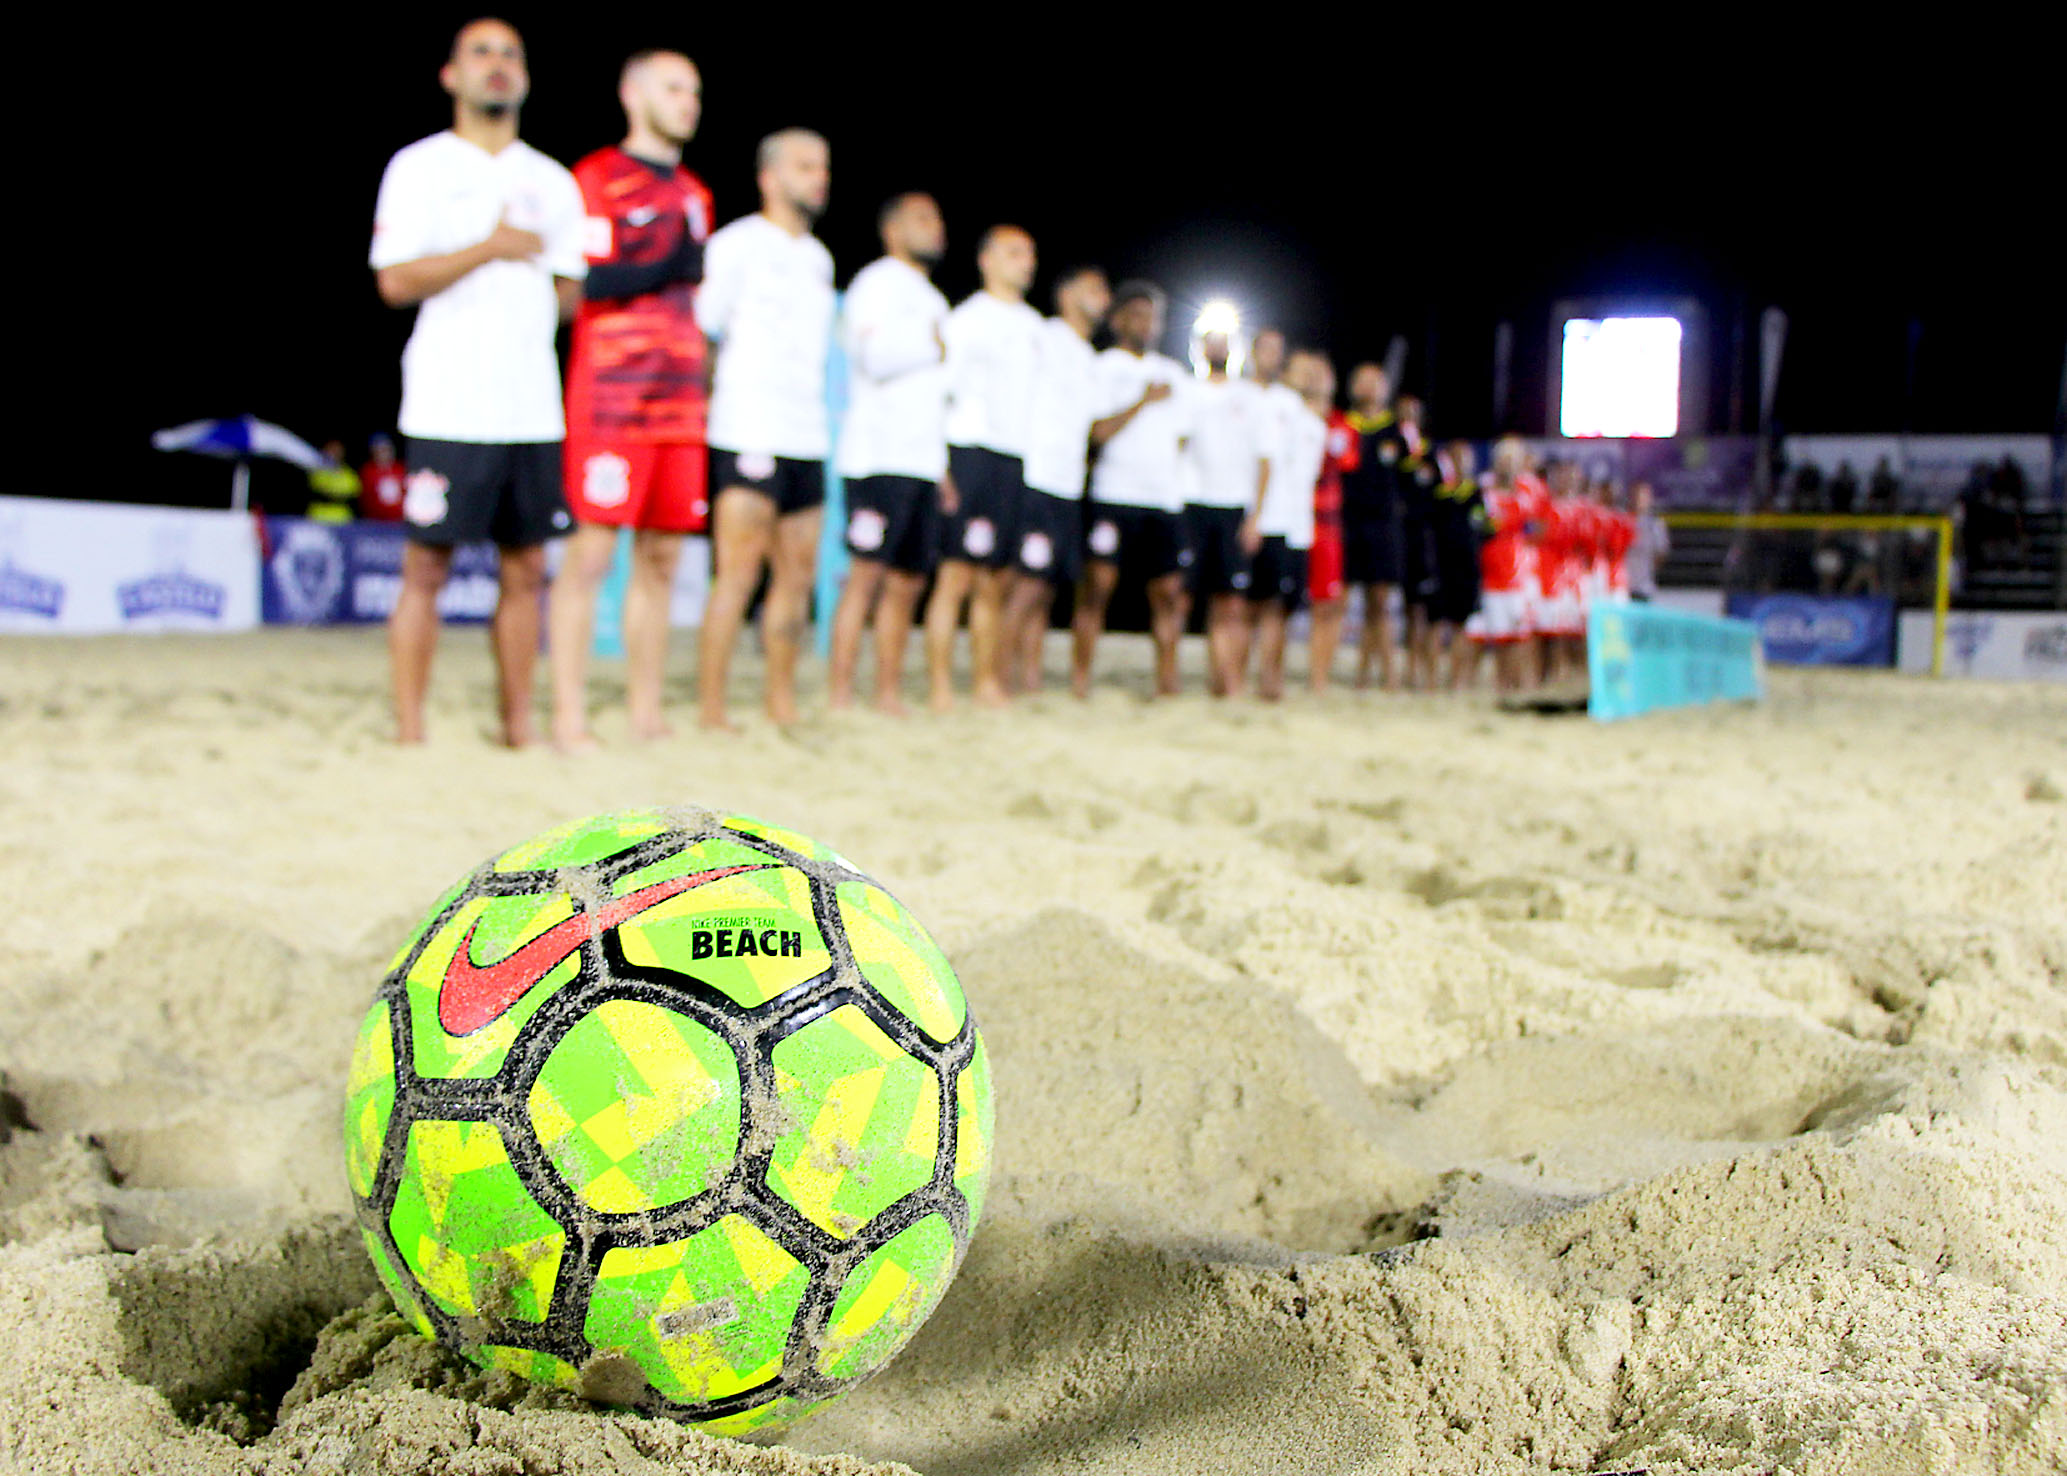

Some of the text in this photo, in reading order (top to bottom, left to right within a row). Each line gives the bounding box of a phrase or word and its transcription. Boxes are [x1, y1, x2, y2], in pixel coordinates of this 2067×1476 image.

[692, 917, 776, 929] NIKE PREMIER TEAM
[692, 929, 801, 960] BEACH
